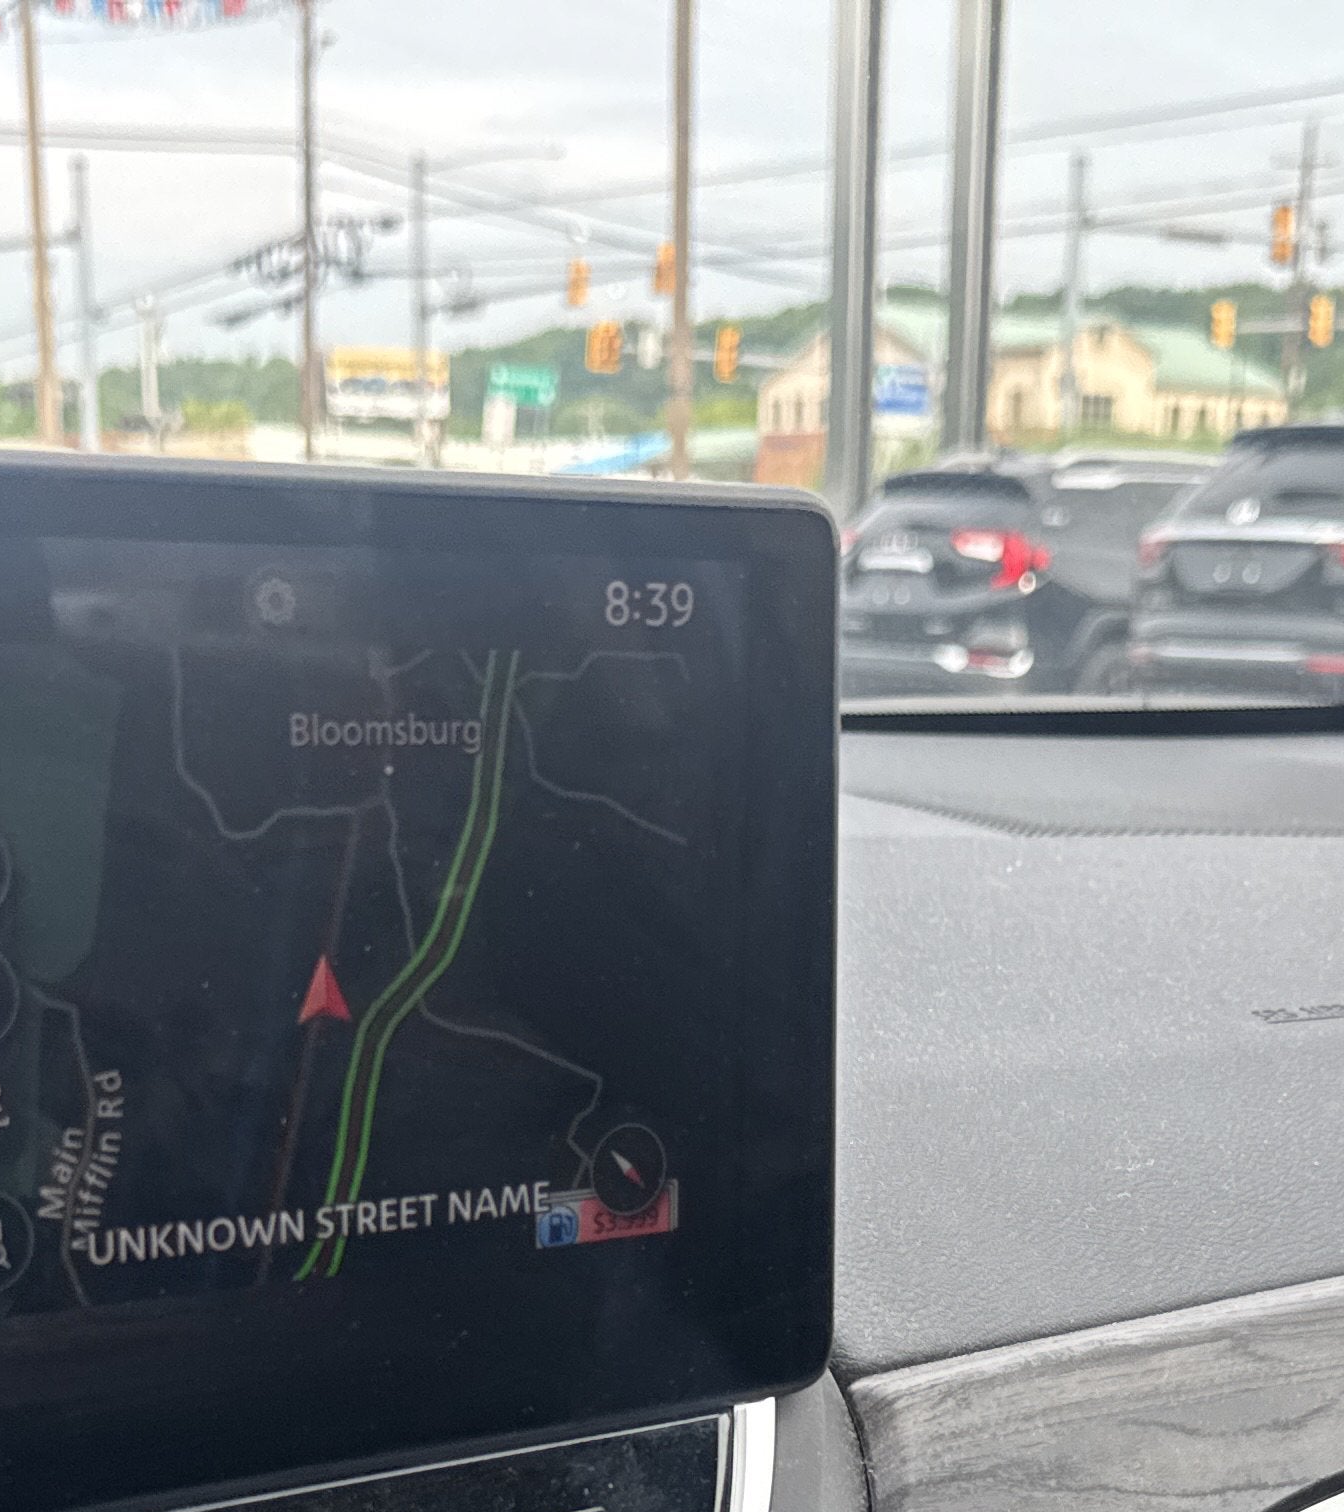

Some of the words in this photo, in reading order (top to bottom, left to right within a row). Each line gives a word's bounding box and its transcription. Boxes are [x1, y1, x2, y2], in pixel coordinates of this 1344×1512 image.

[605, 580, 695, 628] 8:39
[288, 711, 483, 755] Bloomsburg
[94, 1068, 126, 1118] Rd
[37, 1126, 84, 1220] Main
[71, 1130, 123, 1251] Mifflin
[87, 1208, 306, 1267] UNKNOWN
[315, 1193, 440, 1240] STREET
[447, 1180, 552, 1223] NAME
